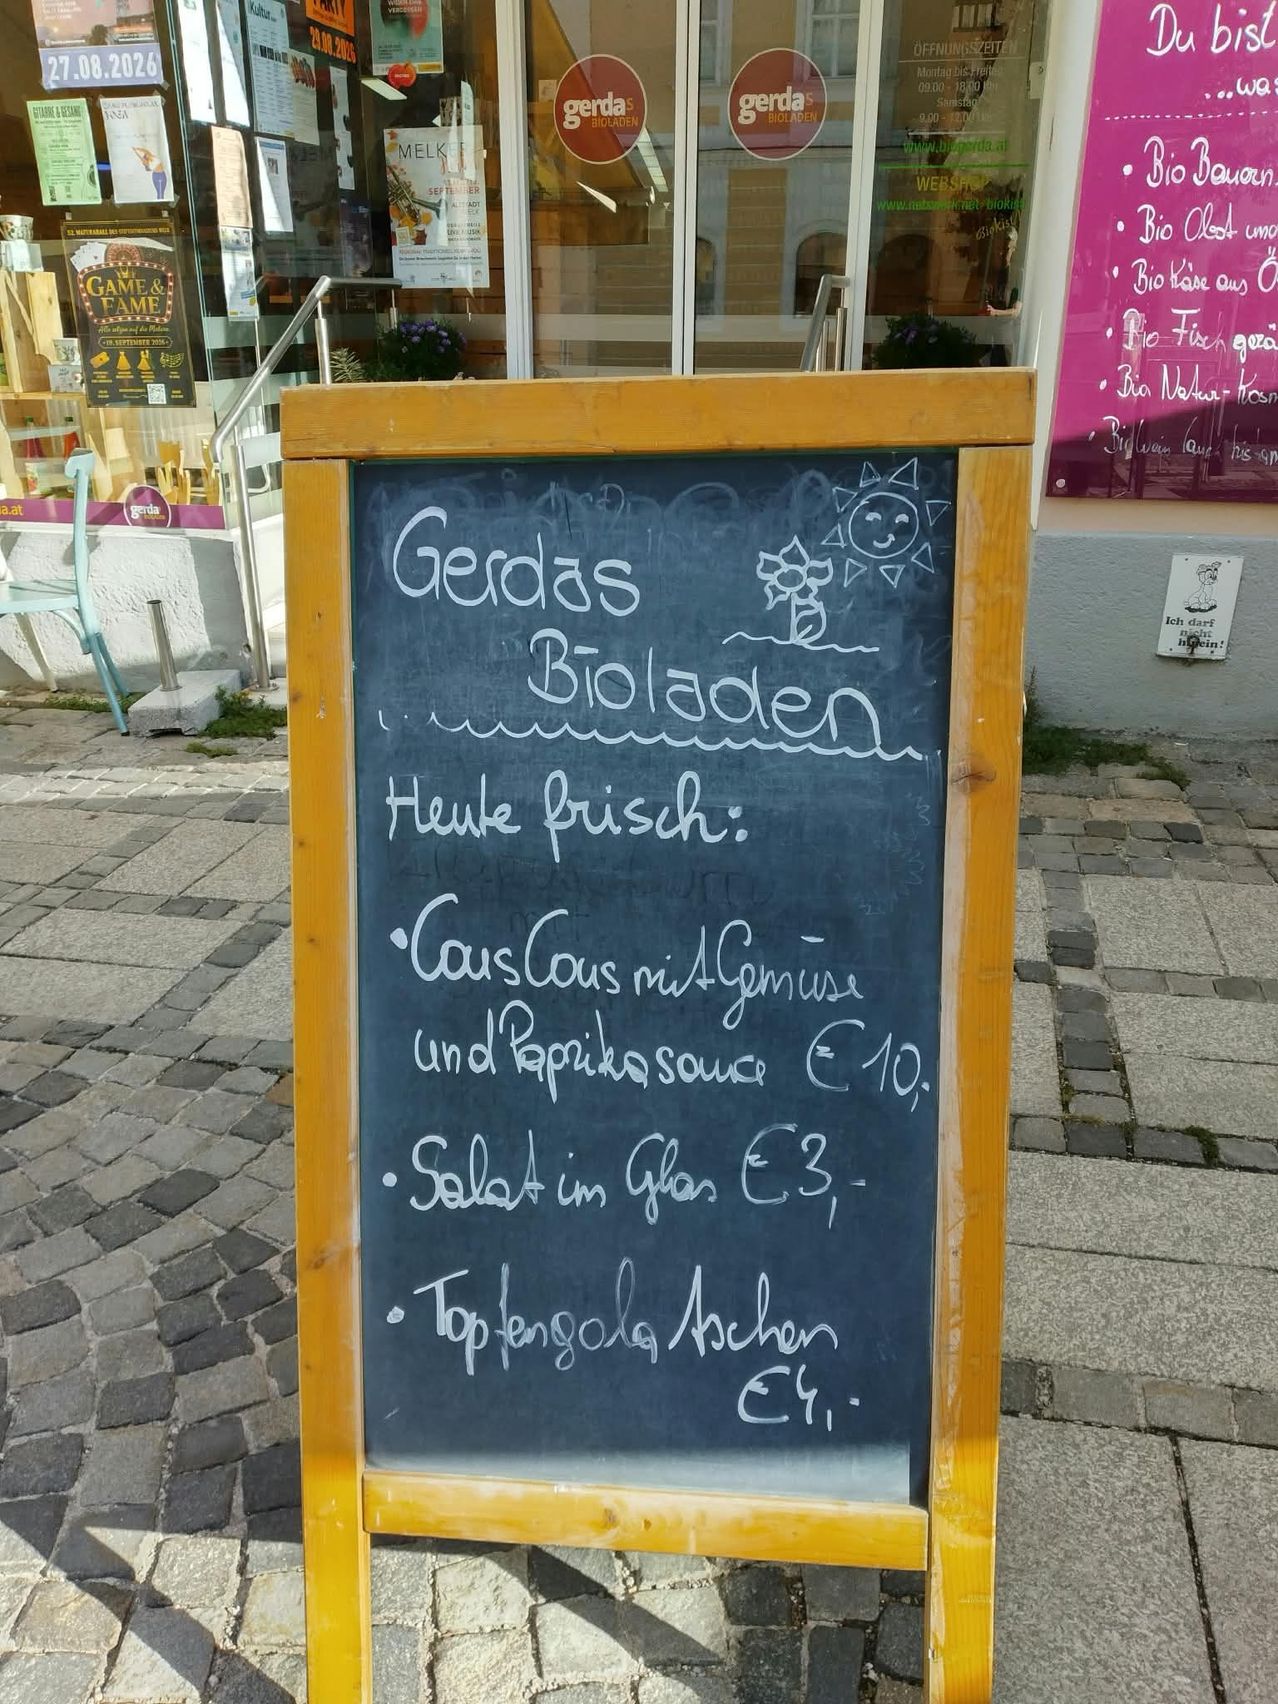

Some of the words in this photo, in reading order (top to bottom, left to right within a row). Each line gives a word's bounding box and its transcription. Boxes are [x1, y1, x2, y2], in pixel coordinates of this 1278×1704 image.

[250, 2, 271, 21] Kultur
[1147, 3, 1196, 56] Du
[1210, 0, 1277, 54] bist
[309, 25, 357, 65] 29.08.2026
[913, 39, 1018, 57] ÖFFNUNGSZEITEN
[48, 52, 158, 81] 27.08.2026
[917, 66, 951, 79] Montag
[955, 65, 969, 77] bis
[970, 64, 1001, 78] Freit
[918, 81, 944, 92] 09.00
[936, 97, 978, 110] Samstag
[591, 116, 639, 128] BIOLADEN
[768, 112, 818, 124] BIOLADEN
[919, 112, 939, 124] 9.00
[1144, 136, 1186, 188] Bio
[1191, 137, 1278, 186] Bauern
[916, 175, 990, 191] WEBSHOP
[1137, 204, 1173, 244] Bio
[1131, 258, 1164, 294] Bio
[1170, 257, 1210, 292] Käse
[1216, 273, 1248, 296] aus
[1257, 245, 1278, 292] Ö
[86, 275, 148, 297] GAME
[150, 278, 166, 296] &
[100, 296, 161, 316] FAME
[0, 505, 24, 516] a.at
[393, 506, 641, 617] Gerdas
[1165, 616, 1184, 626] Ich
[1188, 618, 1215, 628] darf
[1178, 638, 1224, 649] hein!
[527, 628, 882, 747] Bioladen
[385, 773, 522, 842] Heute
[543, 769, 749, 864] frisch:
[633, 924, 715, 998] mit
[716, 919, 865, 1031] Gemüse
[414, 1007, 497, 1076] und
[409, 1129, 546, 1212] Salat
[556, 1151, 607, 1208] im
[624, 1132, 718, 1226] Glas
